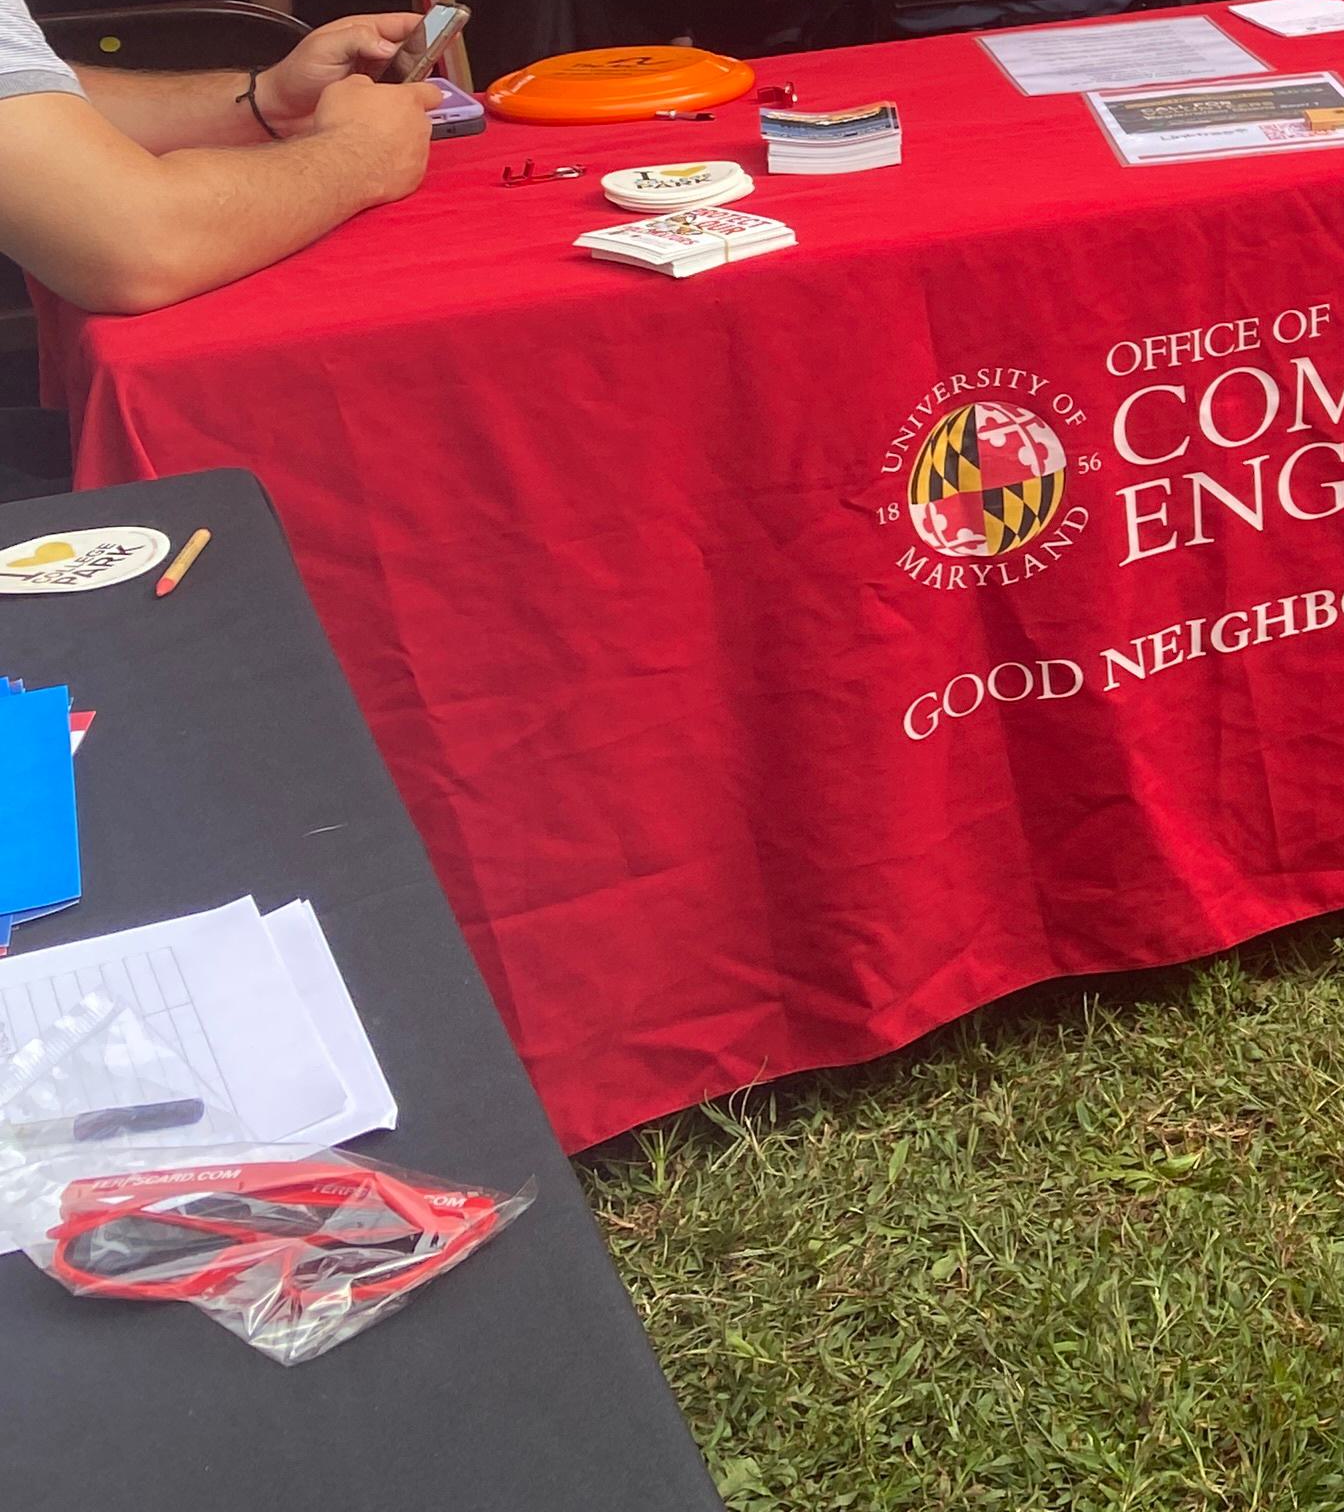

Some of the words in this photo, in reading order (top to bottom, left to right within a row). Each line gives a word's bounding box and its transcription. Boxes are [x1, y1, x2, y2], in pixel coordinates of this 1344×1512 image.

[1106, 316, 1261, 377] OFFICE
[1271, 302, 1333, 347] OF
[881, 366, 1050, 474] UNIVERSITY
[1052, 393, 1088, 427] OF
[1077, 452, 1102, 475] 56
[876, 502, 901, 526] 18
[32, 543, 116, 584] COLLEGE
[50, 545, 145, 585] PARK
[895, 506, 1090, 591] MARYLAND
[902, 656, 1084, 744] GOOD
